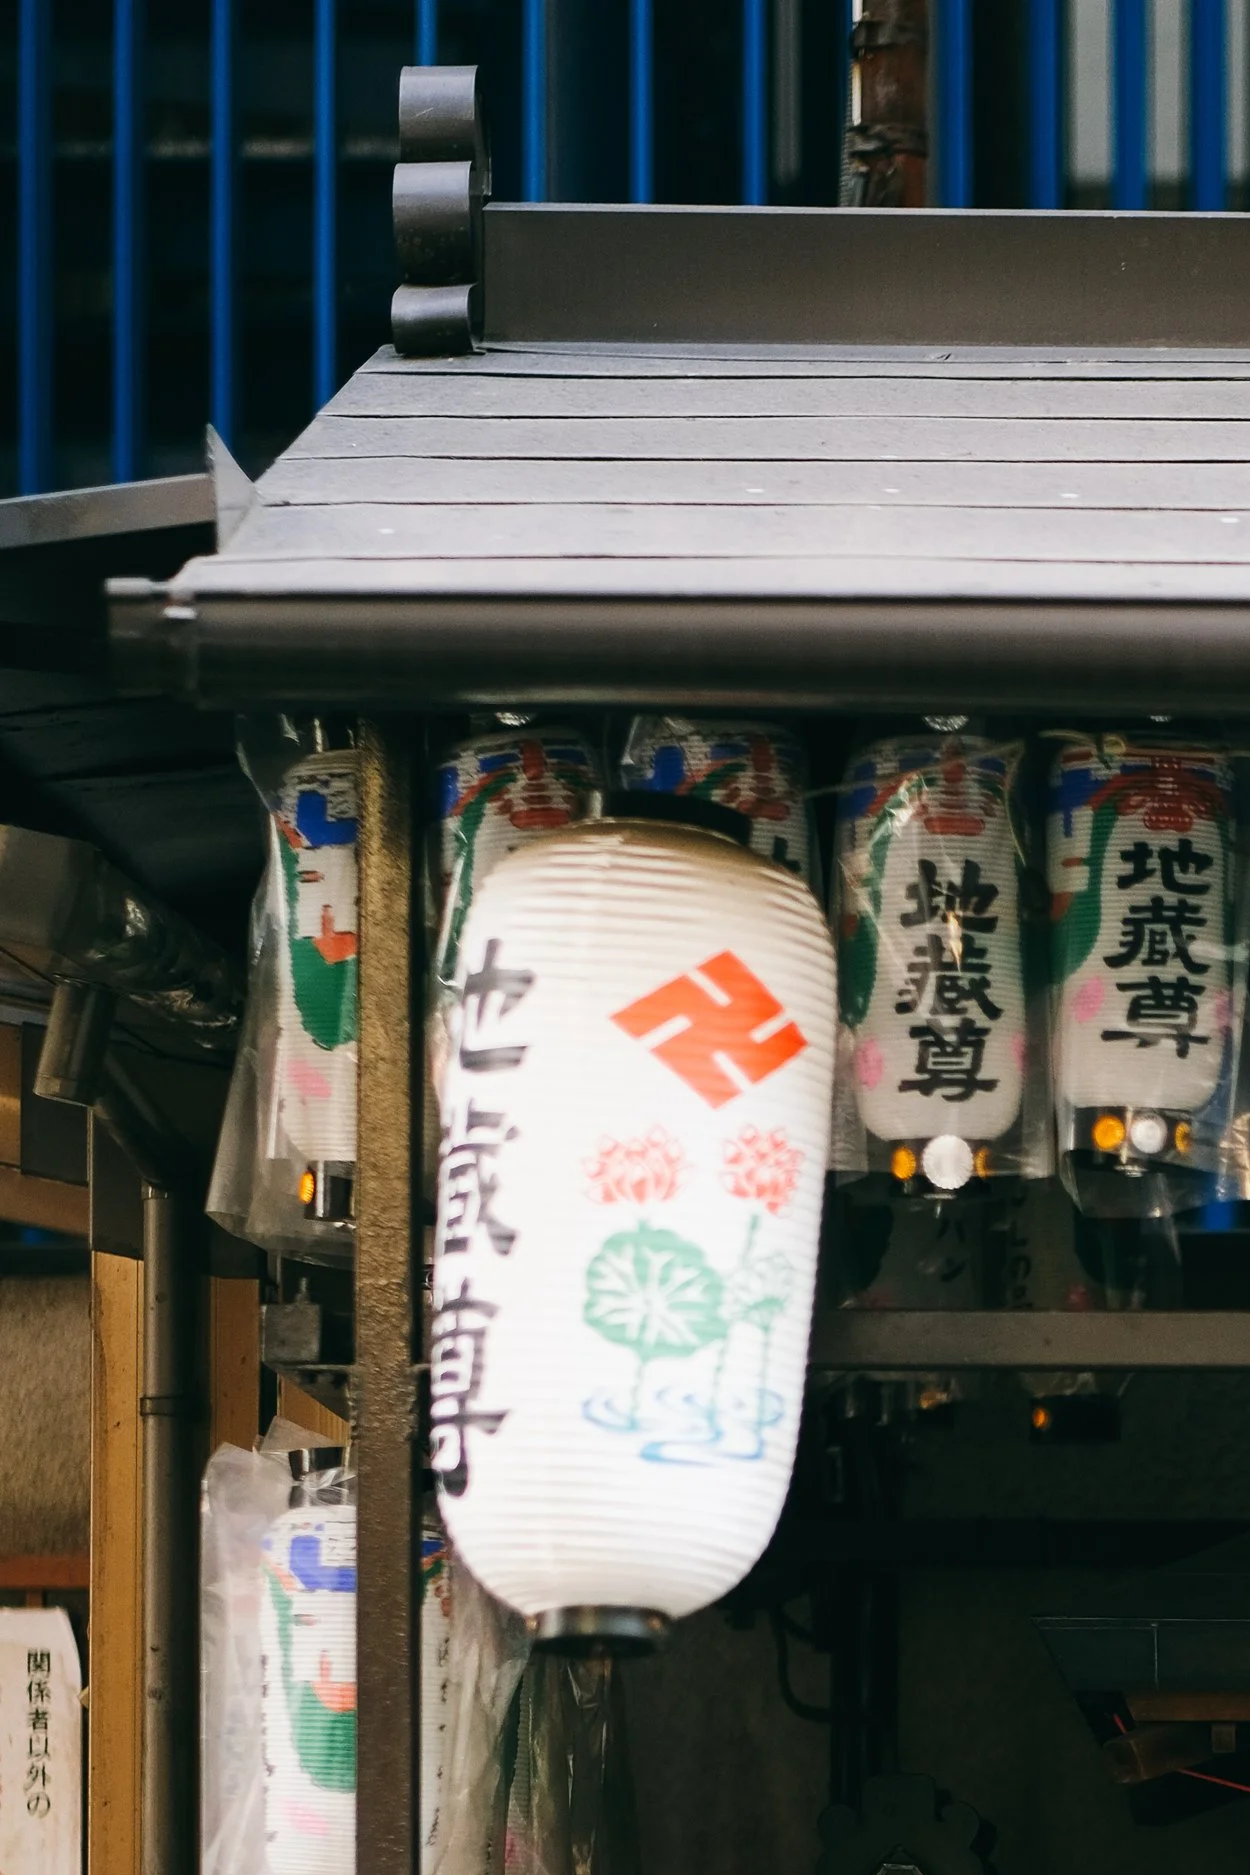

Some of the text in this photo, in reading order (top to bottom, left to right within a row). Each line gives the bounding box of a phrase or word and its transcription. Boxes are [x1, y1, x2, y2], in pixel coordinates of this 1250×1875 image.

[894, 859, 1003, 1102] 地蔵尊
[1104, 839, 1214, 1058] 地蔵尊
[26, 1649, 52, 1818] 関係者以外の
